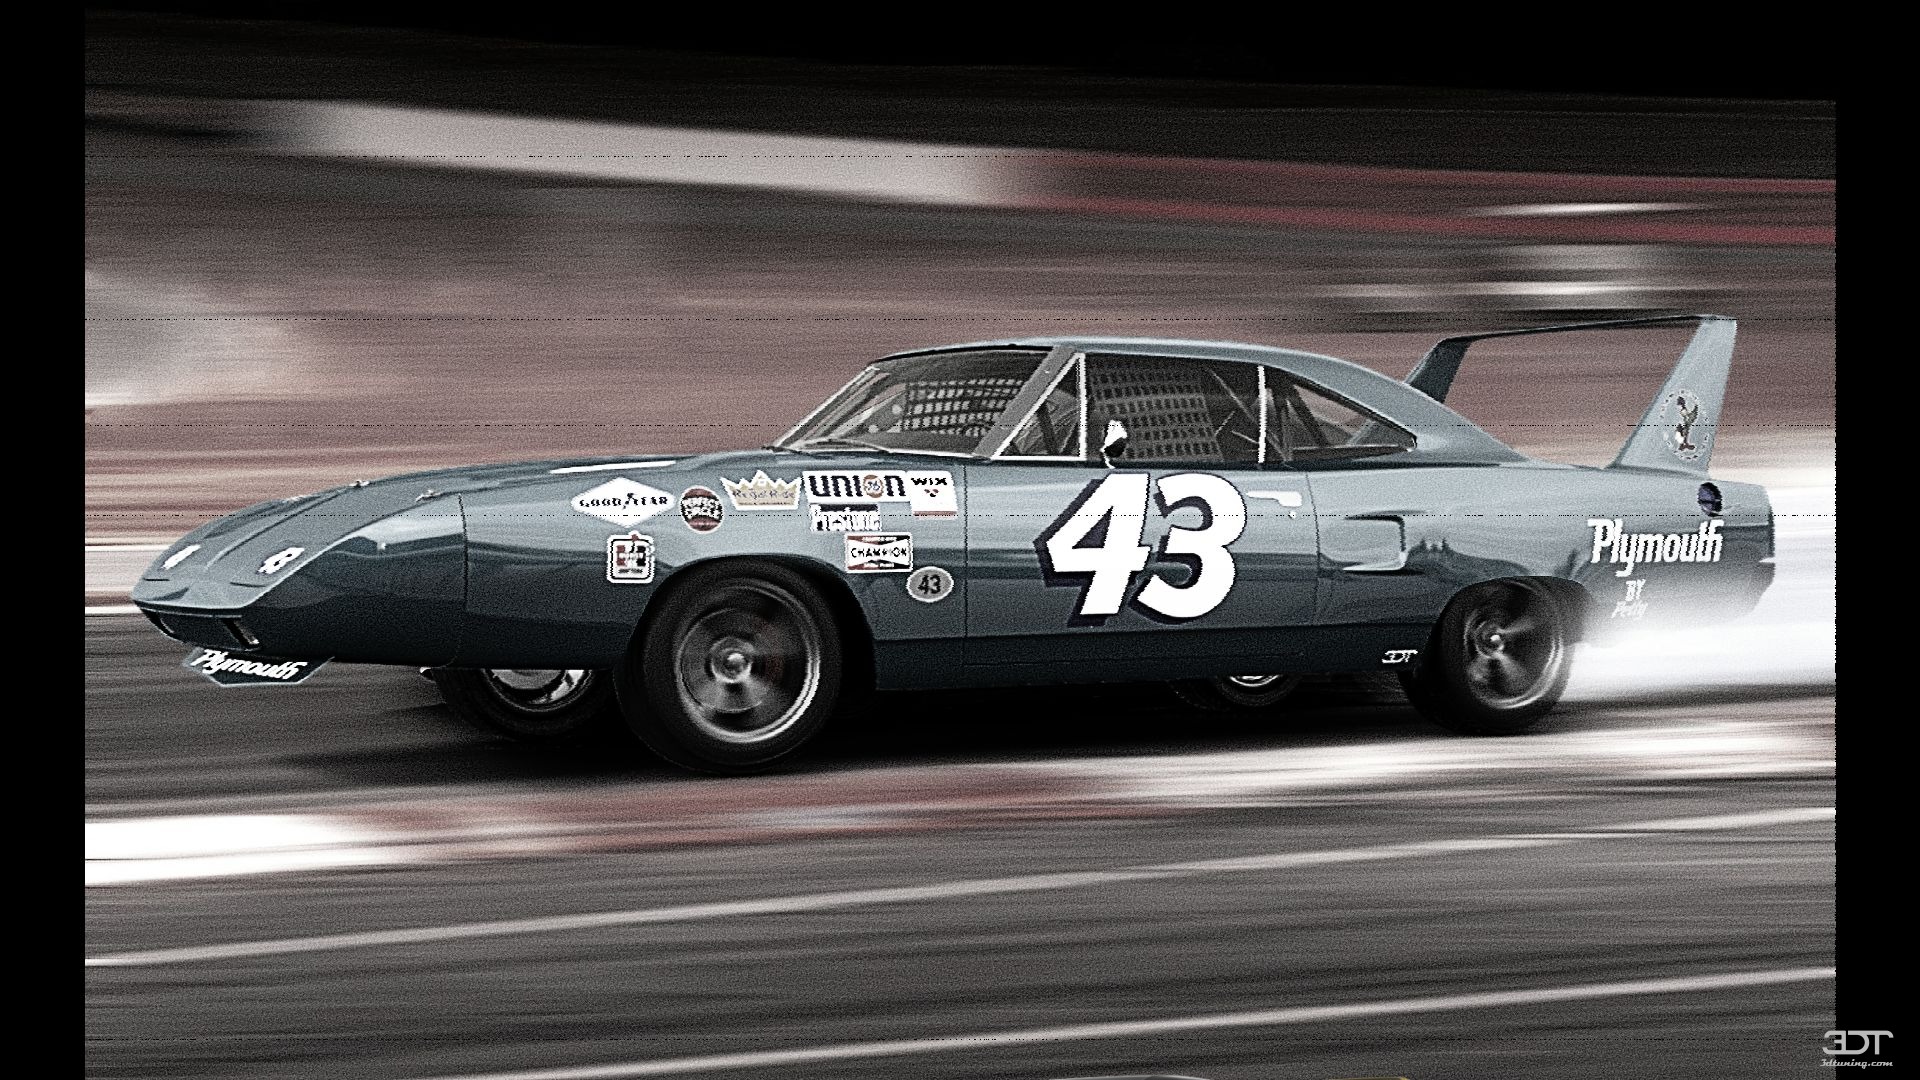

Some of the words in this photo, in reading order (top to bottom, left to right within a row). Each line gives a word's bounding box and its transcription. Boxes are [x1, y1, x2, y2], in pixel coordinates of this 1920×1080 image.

[1034, 472, 1247, 627] 43
[1587, 518, 1724, 578] Plymouth
[918, 574, 942, 595] 43
[1625, 579, 1646, 601] BY
[190, 649, 308, 680] Plymouth
